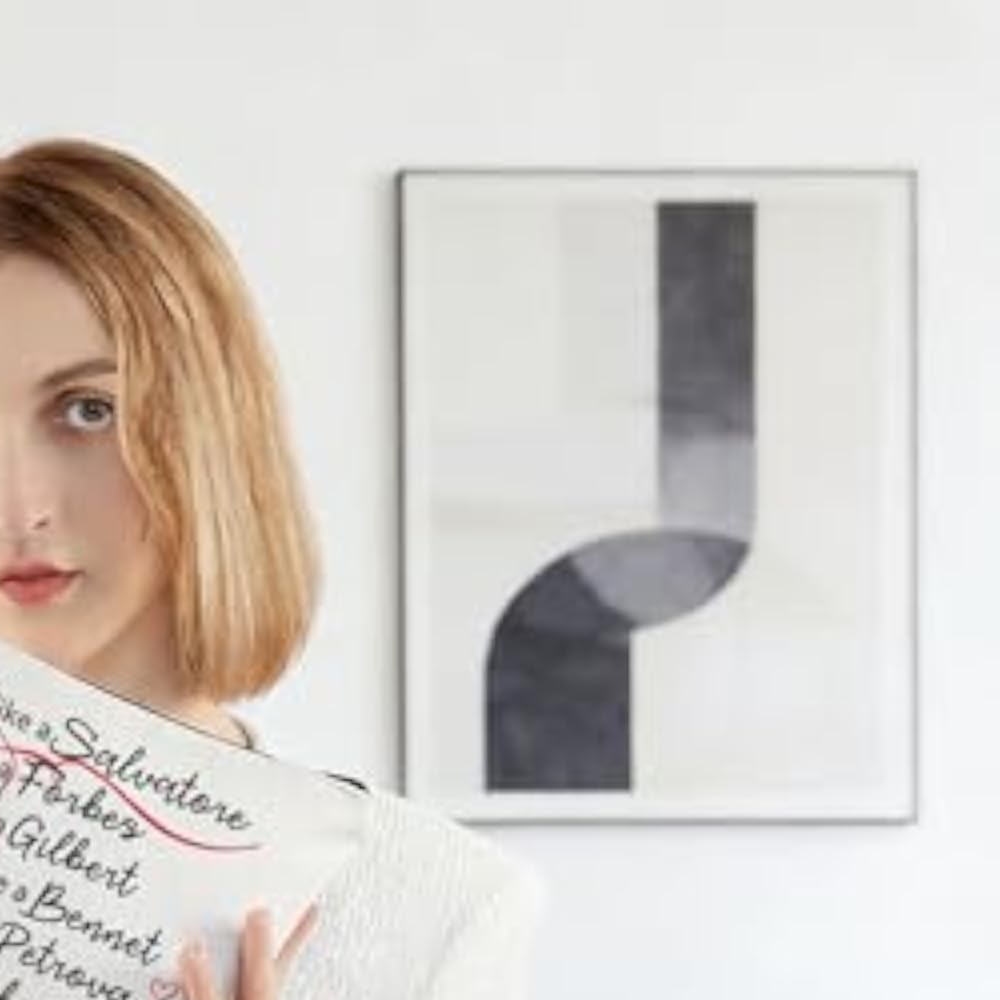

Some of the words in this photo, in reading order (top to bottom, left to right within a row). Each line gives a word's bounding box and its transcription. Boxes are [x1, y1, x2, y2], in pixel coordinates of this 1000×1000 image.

[17, 757, 146, 840] Forbes
[37, 723, 52, 741] a
[50, 717, 251, 831] Salvatore
[6, 814, 143, 897] Gilbert
[13, 885, 27, 902] a
[20, 881, 163, 966] Bennet
